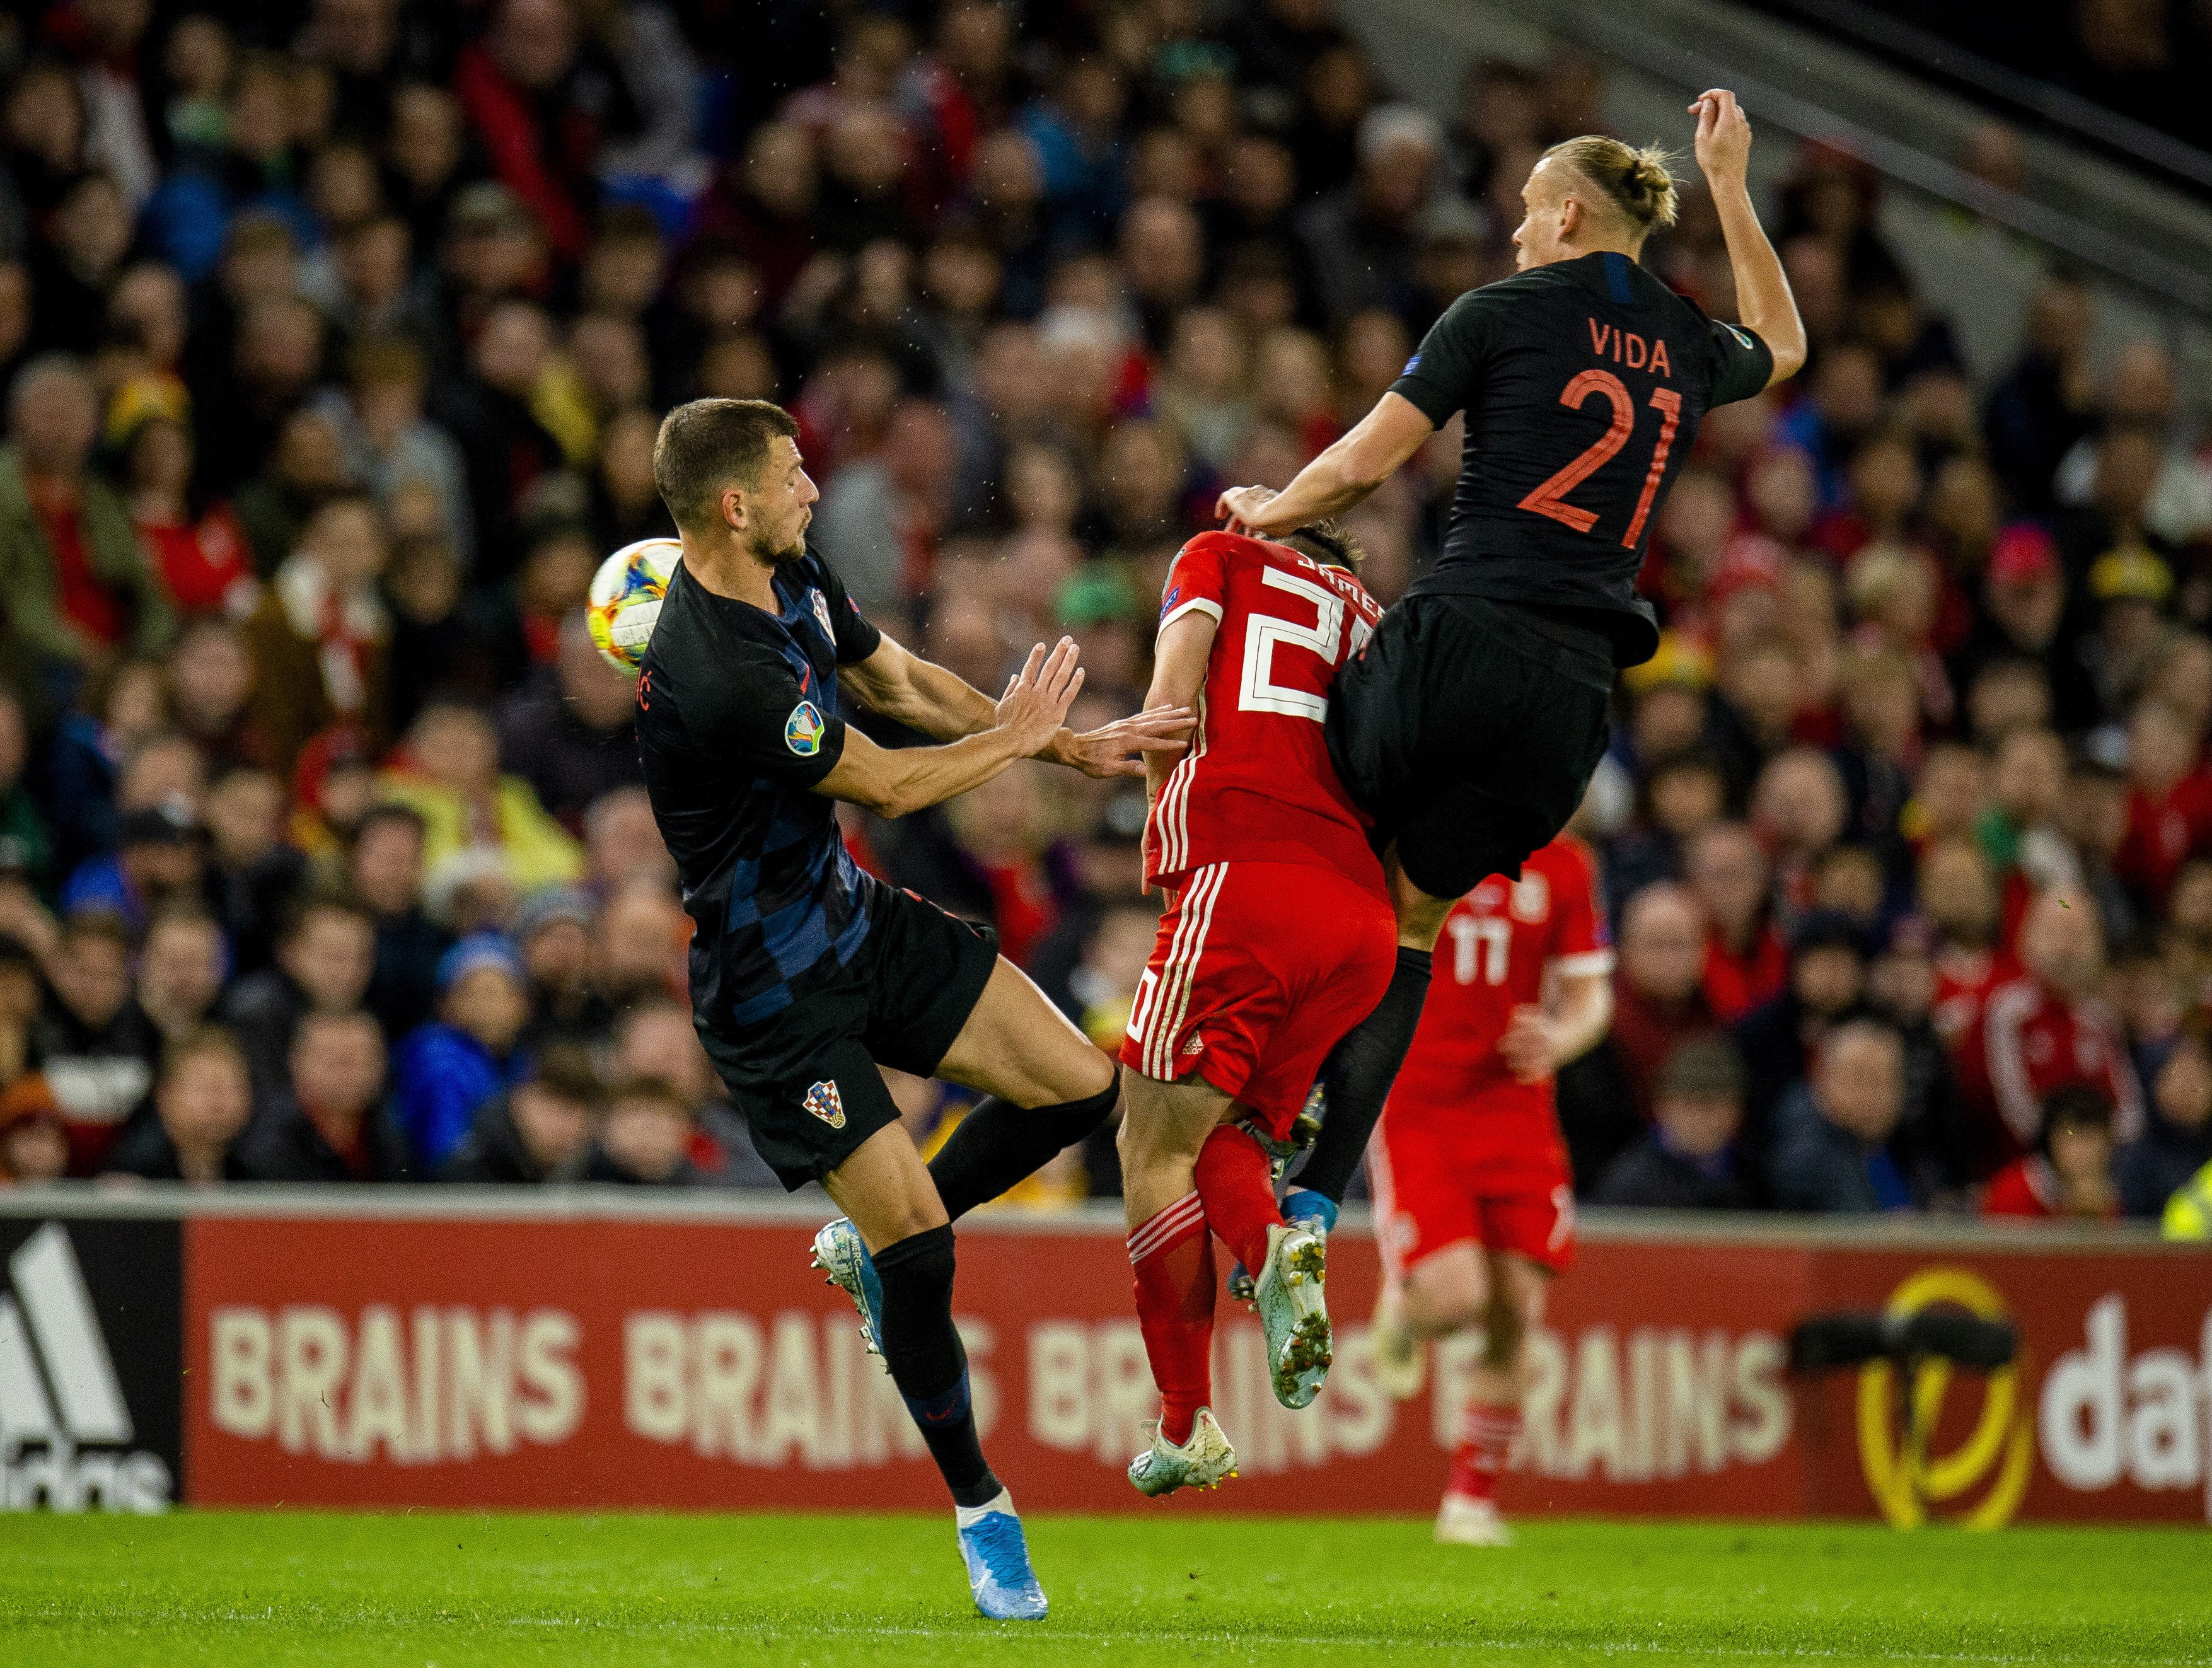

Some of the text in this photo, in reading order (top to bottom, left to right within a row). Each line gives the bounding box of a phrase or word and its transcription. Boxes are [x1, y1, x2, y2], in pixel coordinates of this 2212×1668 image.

[1589, 318, 1671, 378] VIDA
[1516, 369, 1682, 550] 21
[210, 1304, 585, 1466] BRAINS
